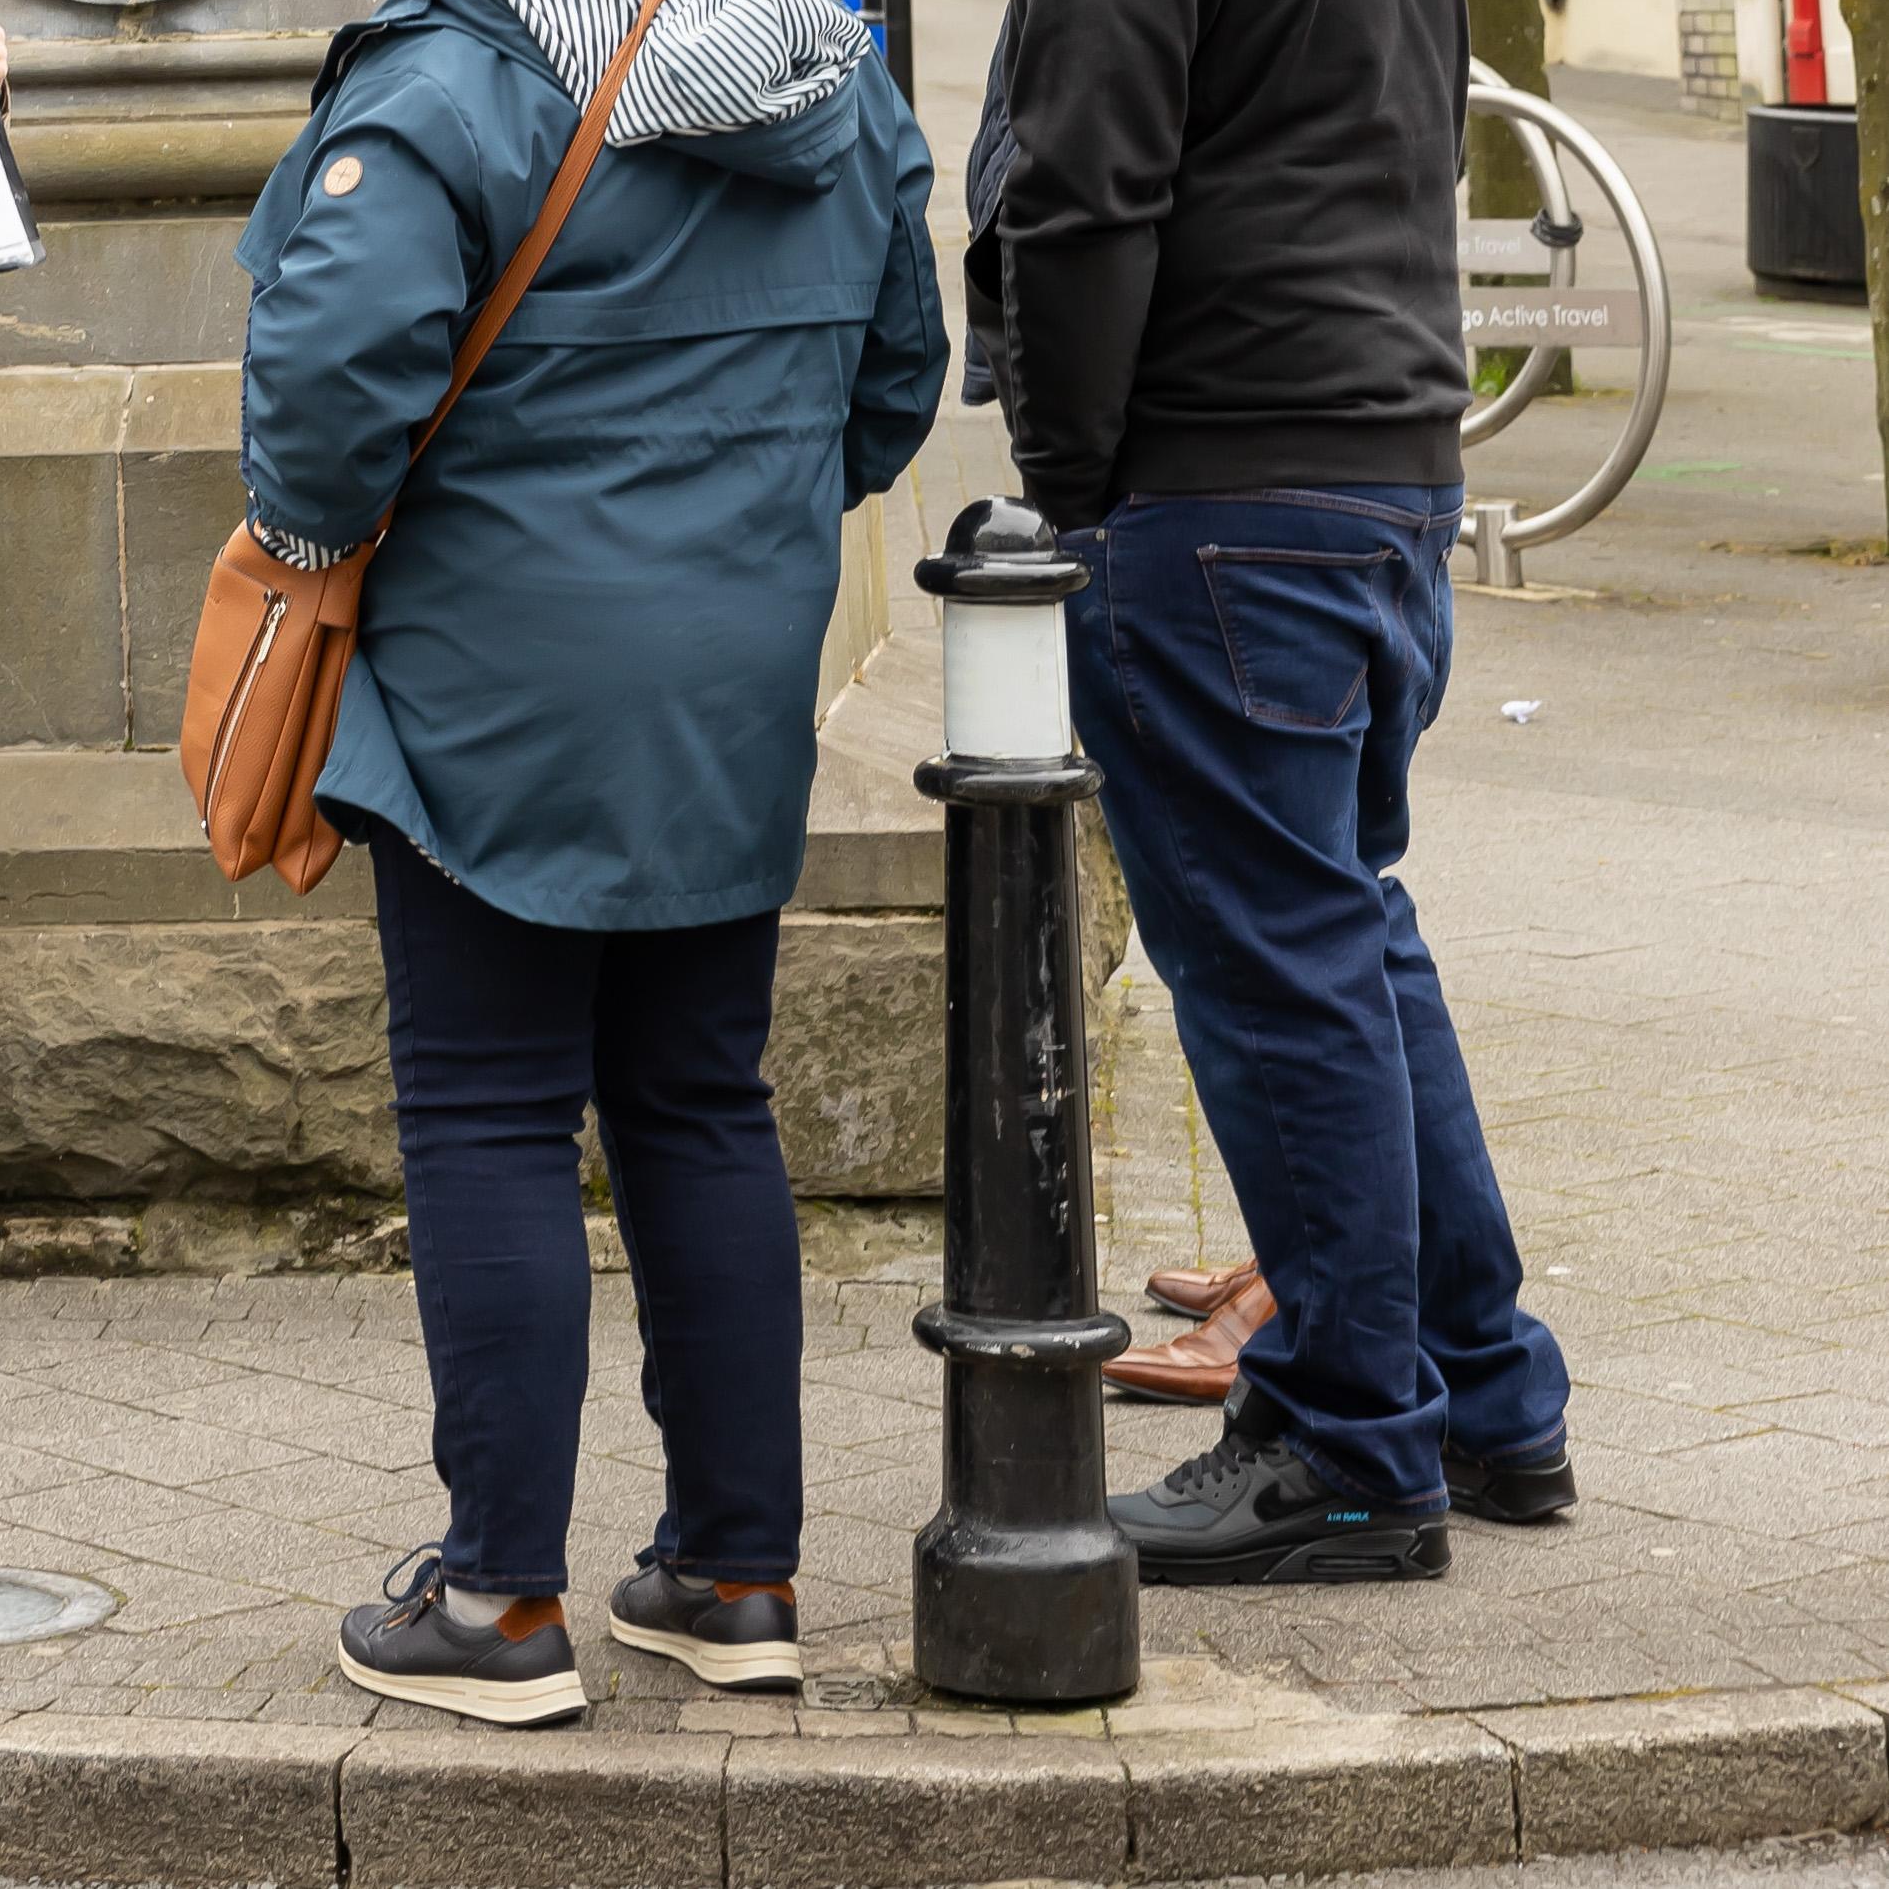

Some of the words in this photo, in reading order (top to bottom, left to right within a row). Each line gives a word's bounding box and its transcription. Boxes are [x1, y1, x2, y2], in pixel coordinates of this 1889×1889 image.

[1474, 235, 1521, 254] Travel
[1488, 304, 1548, 327] Active
[1552, 302, 1609, 327] Travel
